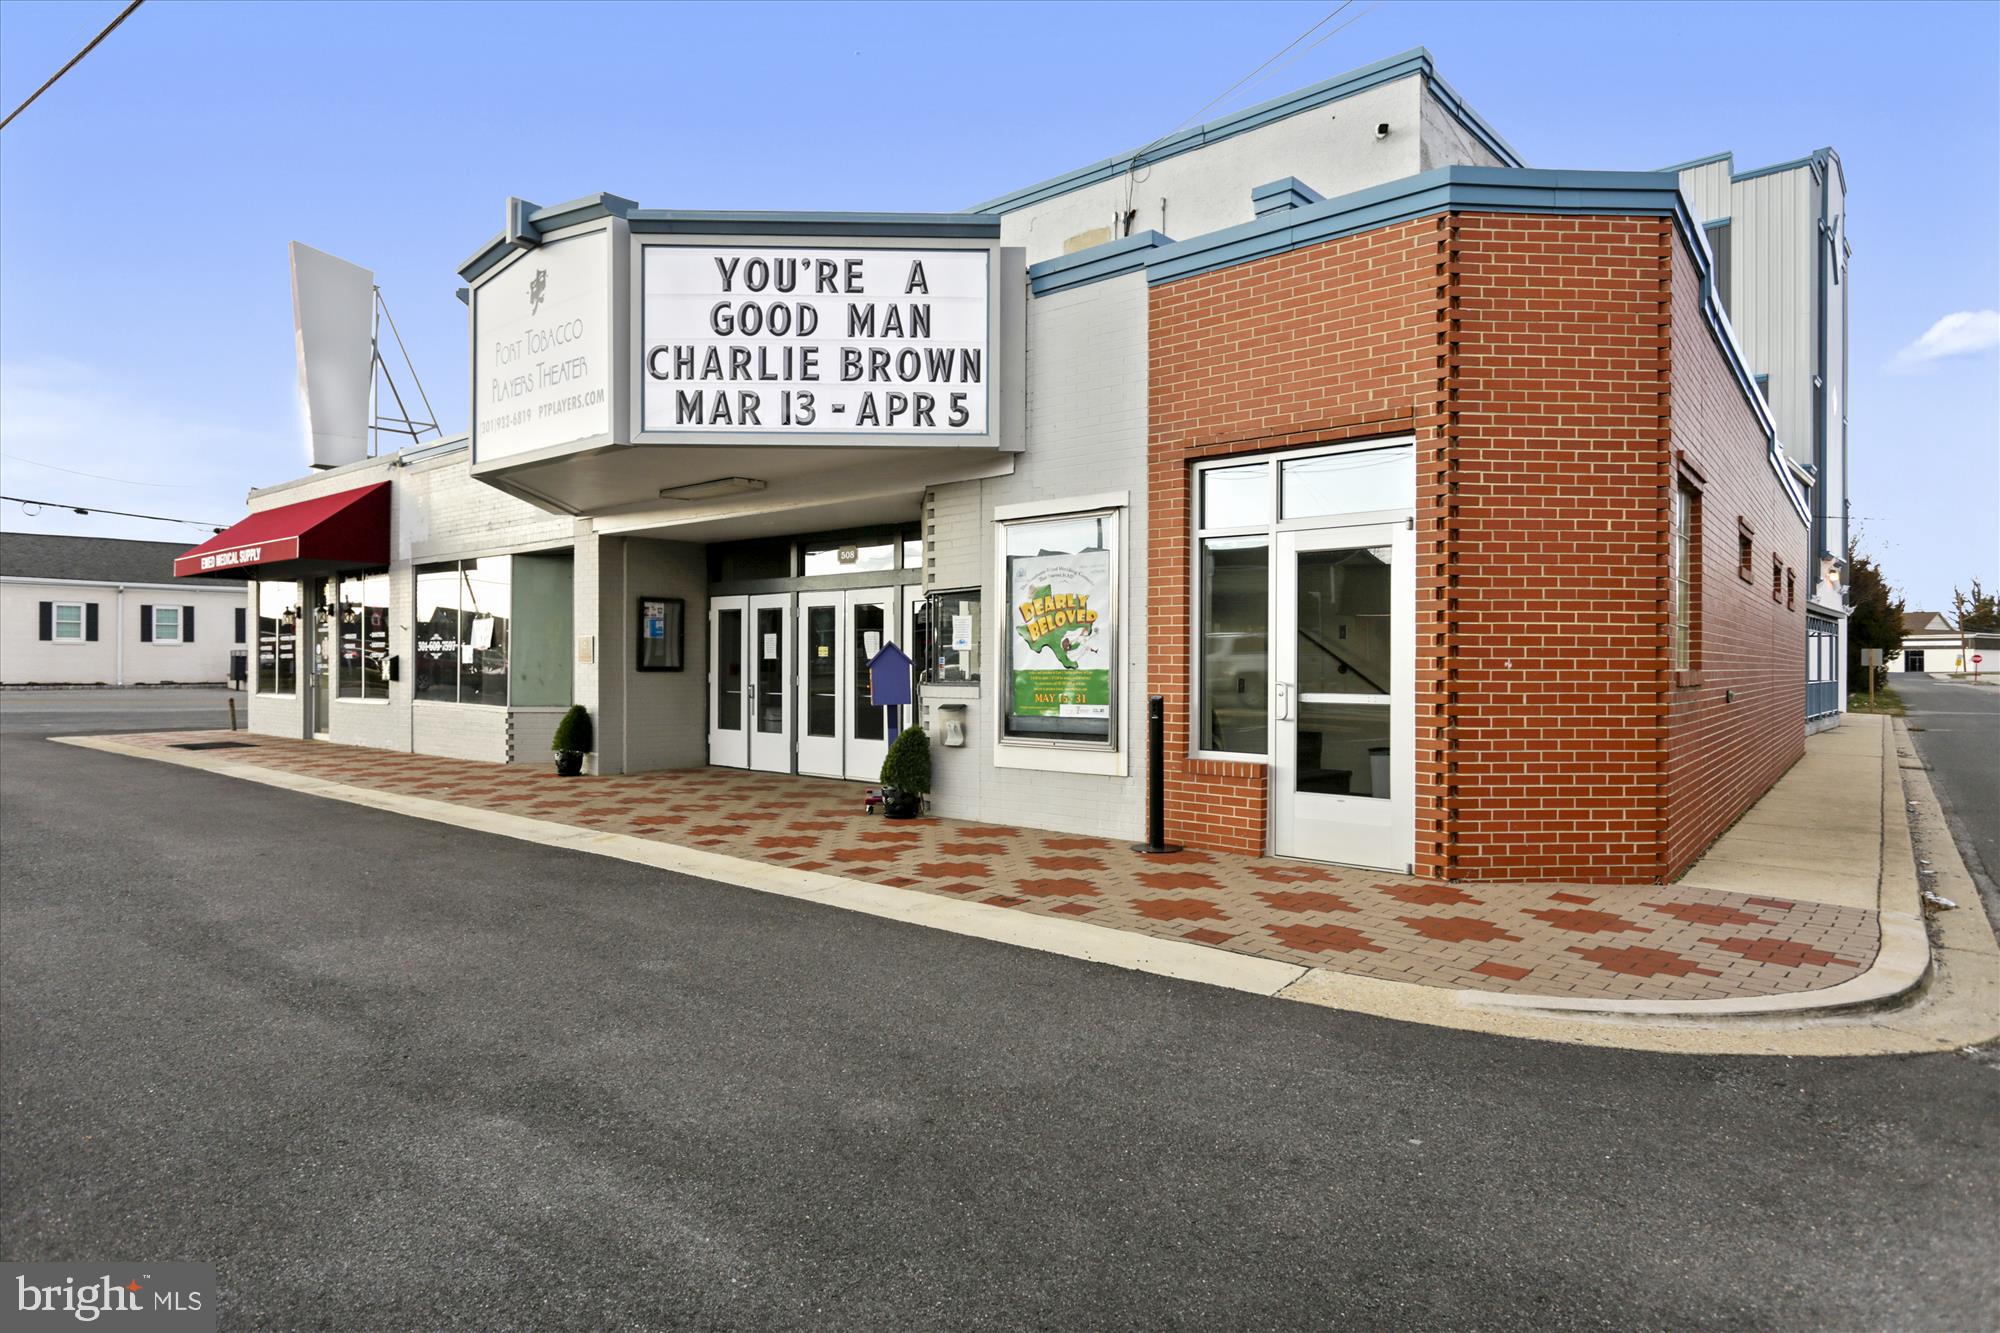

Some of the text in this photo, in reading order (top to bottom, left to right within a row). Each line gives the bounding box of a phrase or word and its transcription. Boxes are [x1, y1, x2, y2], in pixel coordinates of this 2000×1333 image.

[714, 256, 929, 294] YOU'RE A
[709, 300, 931, 338] GOOD MAN
[495, 318, 584, 368] PORT TOBACCO
[491, 355, 588, 404] PLAYERS THEATER
[646, 344, 981, 383] CHARLIE BROWN
[538, 387, 605, 419] PTPLAYERS.COM
[675, 389, 762, 425] MAR
[781, 389, 816, 426] 13
[855, 391, 937, 427] APR
[948, 391, 970, 428] 5
[215, 551, 239, 567] MEDICAL
[239, 547, 262, 563] SUPPLY
[840, 550, 855, 560] 508
[1018, 592, 1089, 623] DEARLY
[1026, 609, 1099, 644] BELOVED
[1034, 693, 1056, 704] MAY
[1075, 693, 1088, 704] 31
